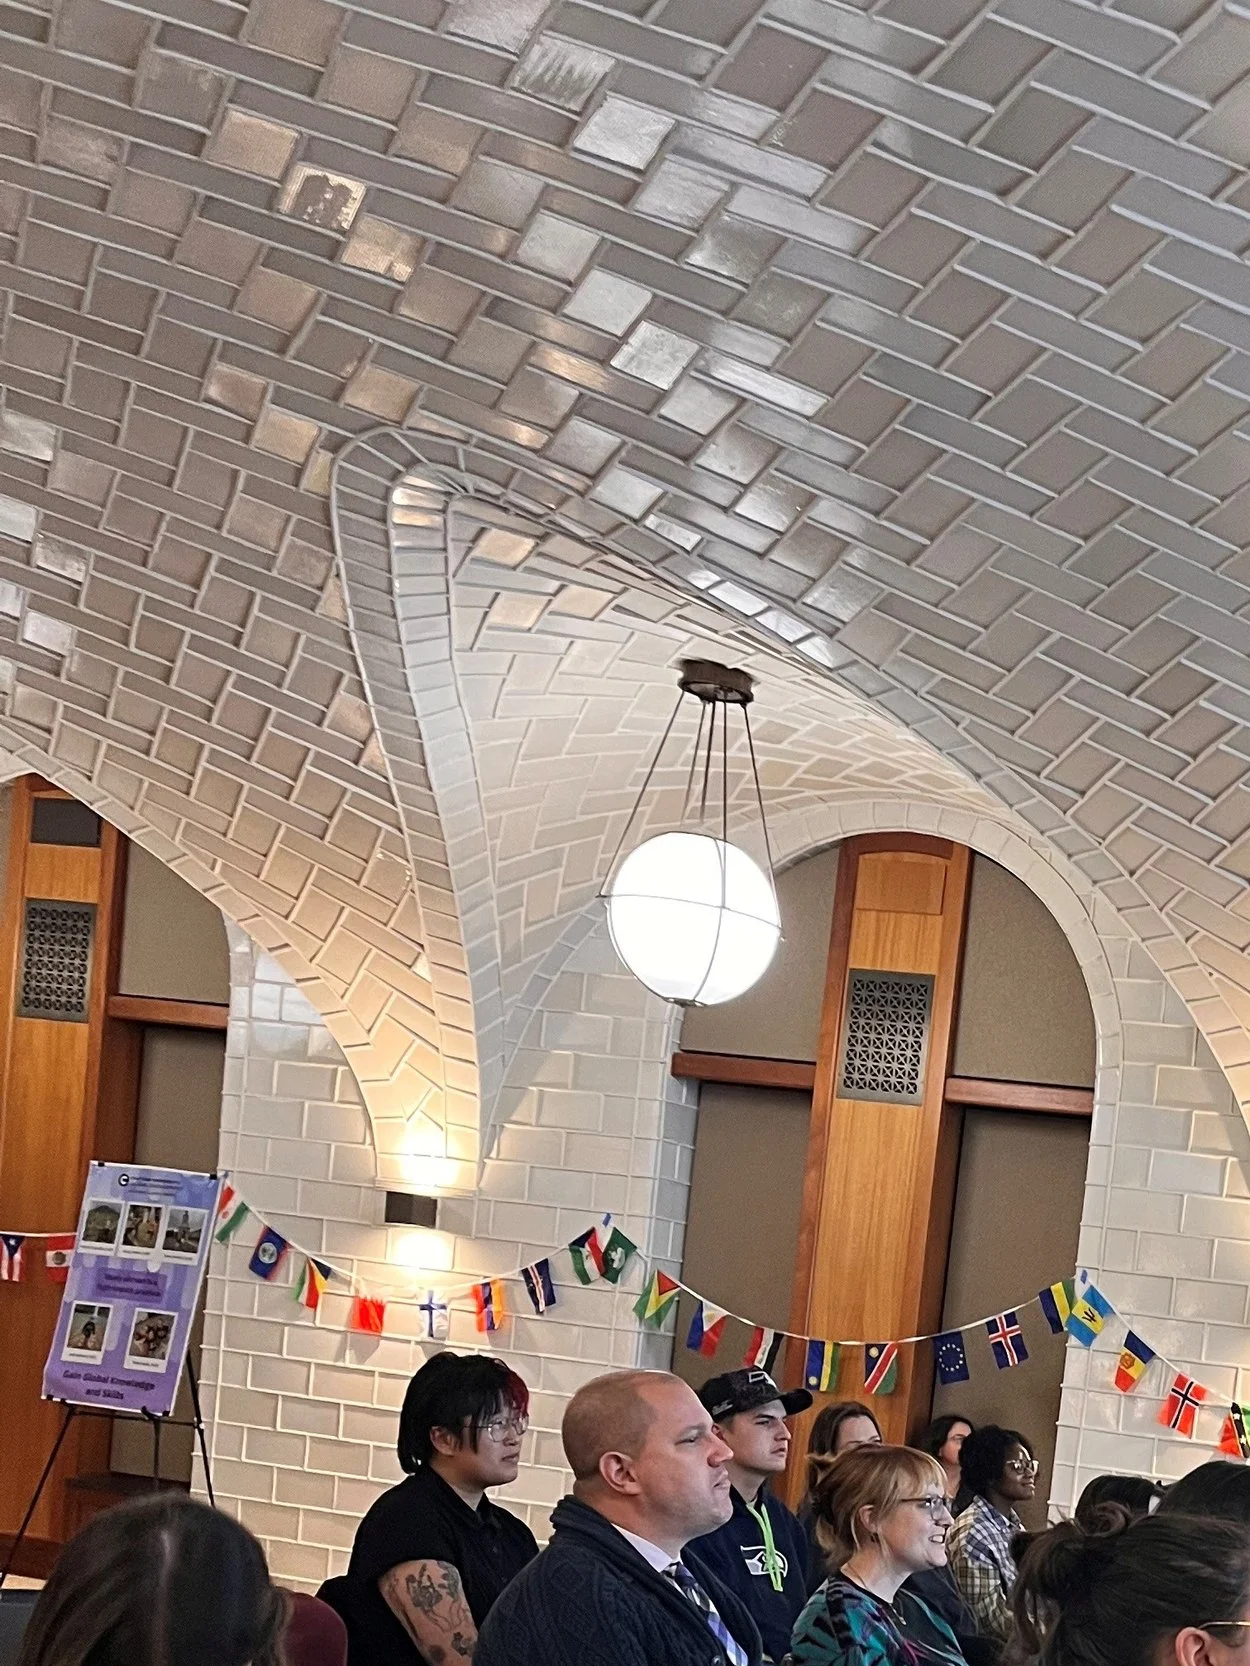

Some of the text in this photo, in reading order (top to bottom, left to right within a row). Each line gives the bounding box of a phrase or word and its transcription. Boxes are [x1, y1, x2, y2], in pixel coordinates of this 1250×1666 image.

[83, 1373, 109, 1383] Global
[110, 1377, 156, 1391] Knowledge
[103, 1389, 124, 1399] Skills
